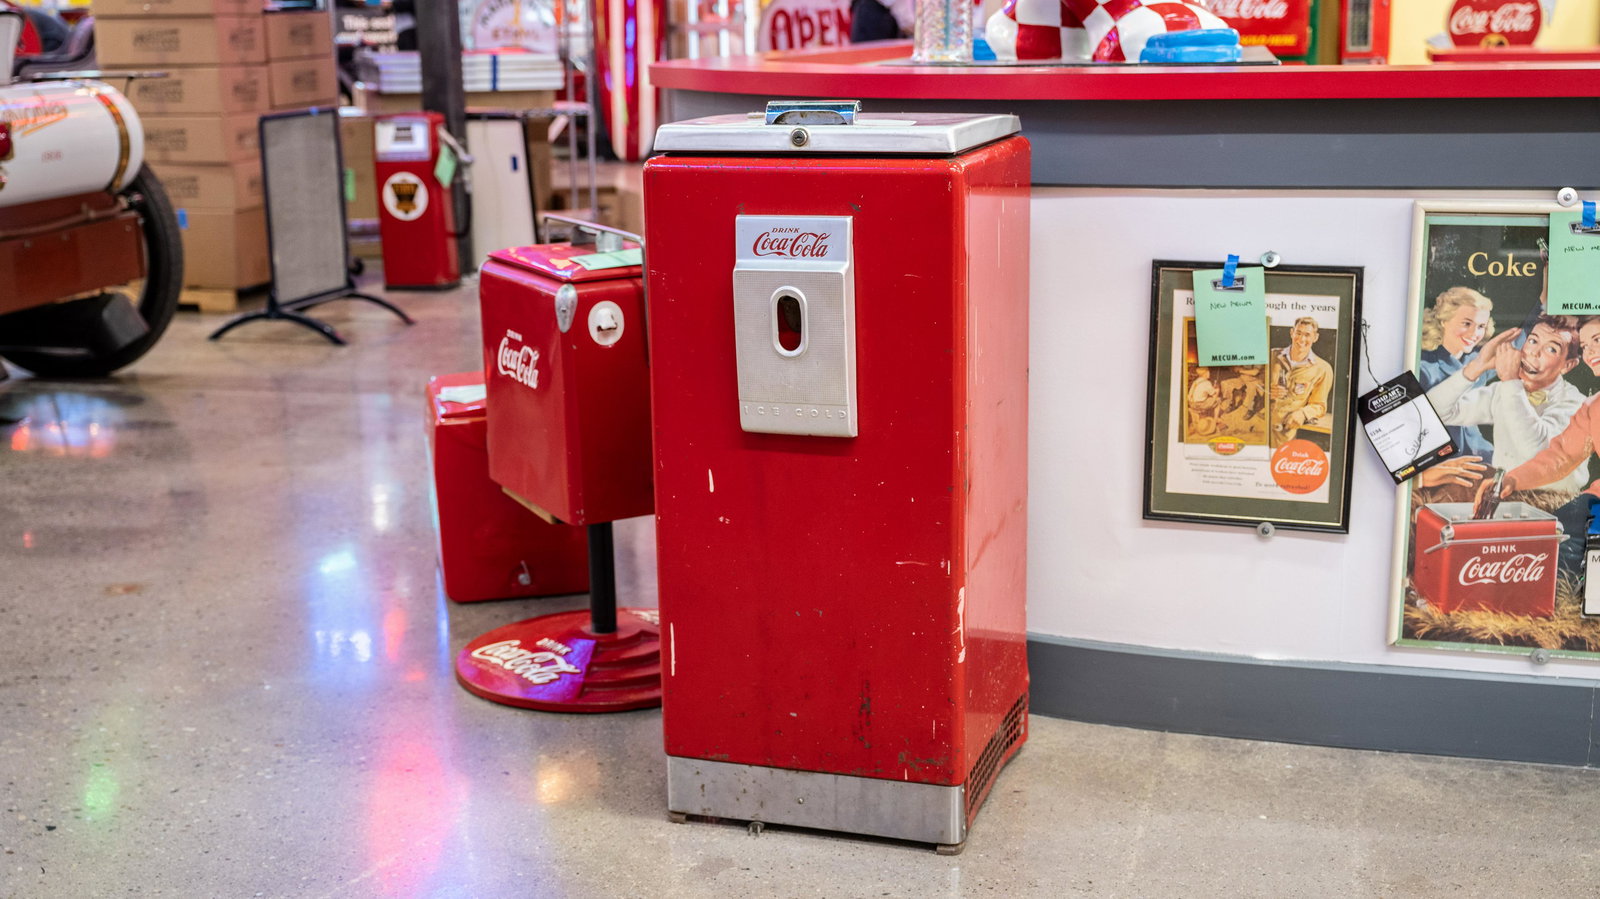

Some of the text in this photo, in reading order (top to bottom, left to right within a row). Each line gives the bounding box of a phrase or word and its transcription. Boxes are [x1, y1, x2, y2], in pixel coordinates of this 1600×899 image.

[1450, 2, 1538, 35] Coca-Cola
[753, 231, 832, 258] Coca-Cola
[1467, 251, 1537, 277] Coke
[1290, 303, 1307, 312] the
[1310, 304, 1336, 313] years
[498, 337, 540, 389] Coca-Cola
[1372, 387, 1402, 406] ROAD ART
[744, 406, 847, 419] ICE COLD
[1274, 458, 1324, 476] Coca-Cola
[1482, 544, 1517, 554] DRINK
[1459, 553, 1549, 586] Coca-Cola
[471, 640, 581, 684] Coca-Cola
